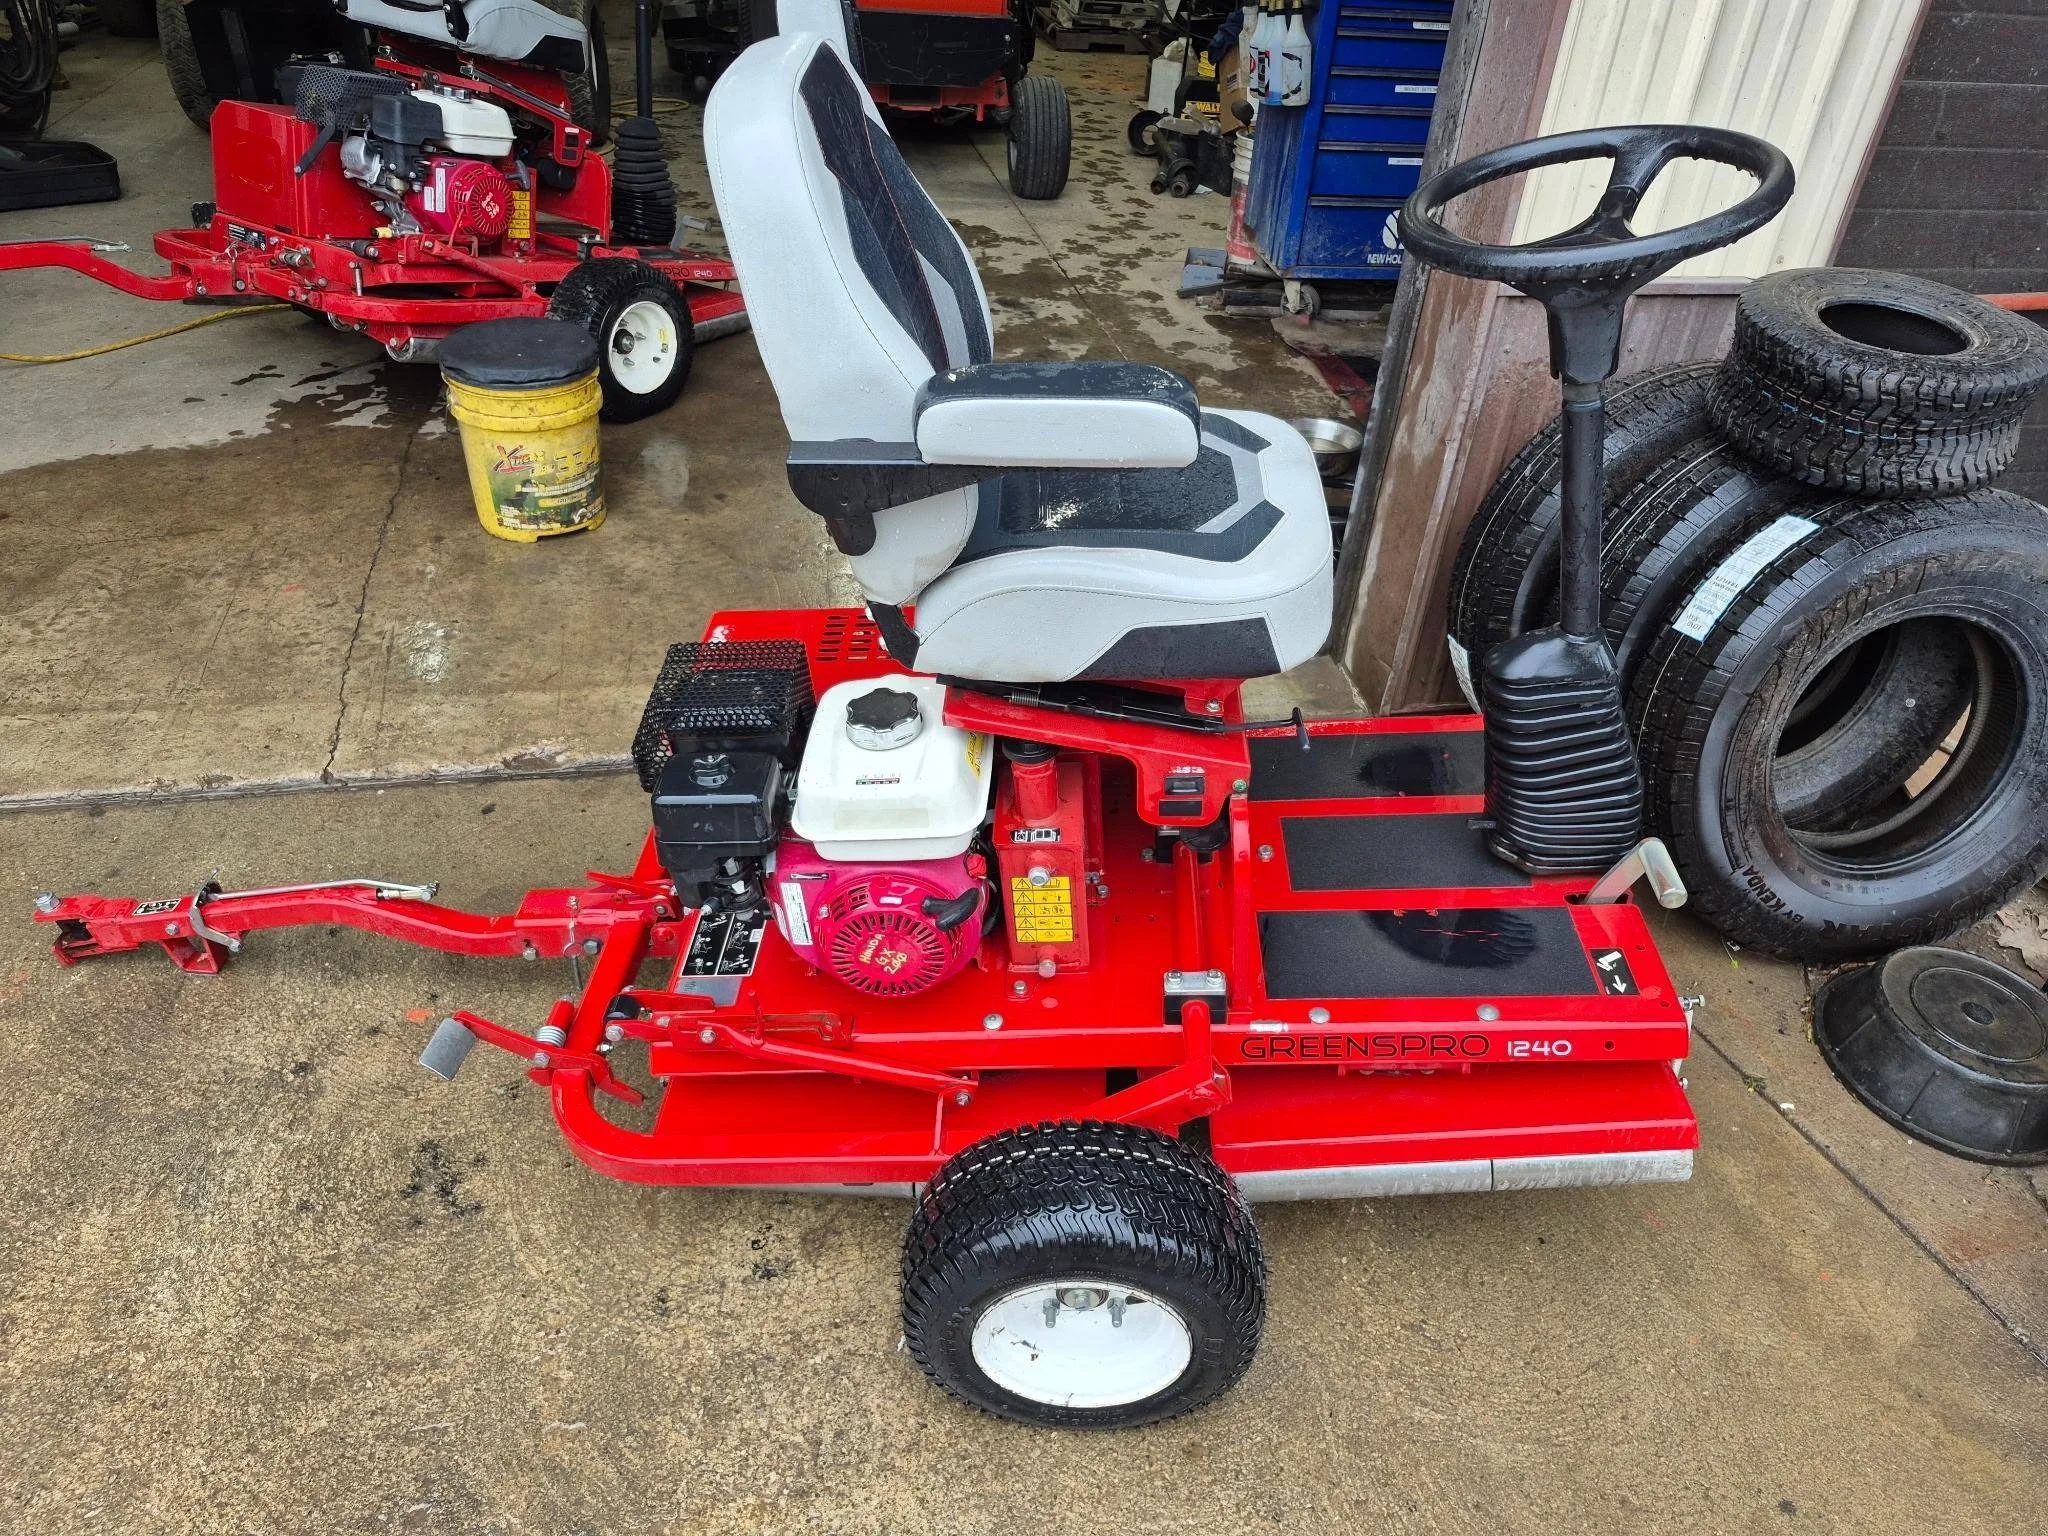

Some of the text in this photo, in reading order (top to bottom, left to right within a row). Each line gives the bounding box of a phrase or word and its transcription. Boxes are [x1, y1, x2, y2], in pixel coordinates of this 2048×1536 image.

[1366, 253, 1386, 264] NEW
[693, 270, 713, 278] 1240
[1742, 865, 1787, 913] KENDA
[1781, 909, 1805, 923] BY
[858, 933, 885, 964] HONDA
[874, 947, 896, 966] GX
[883, 951, 908, 975] 200
[1240, 1034, 1573, 1060] GREENSPRO 1240
